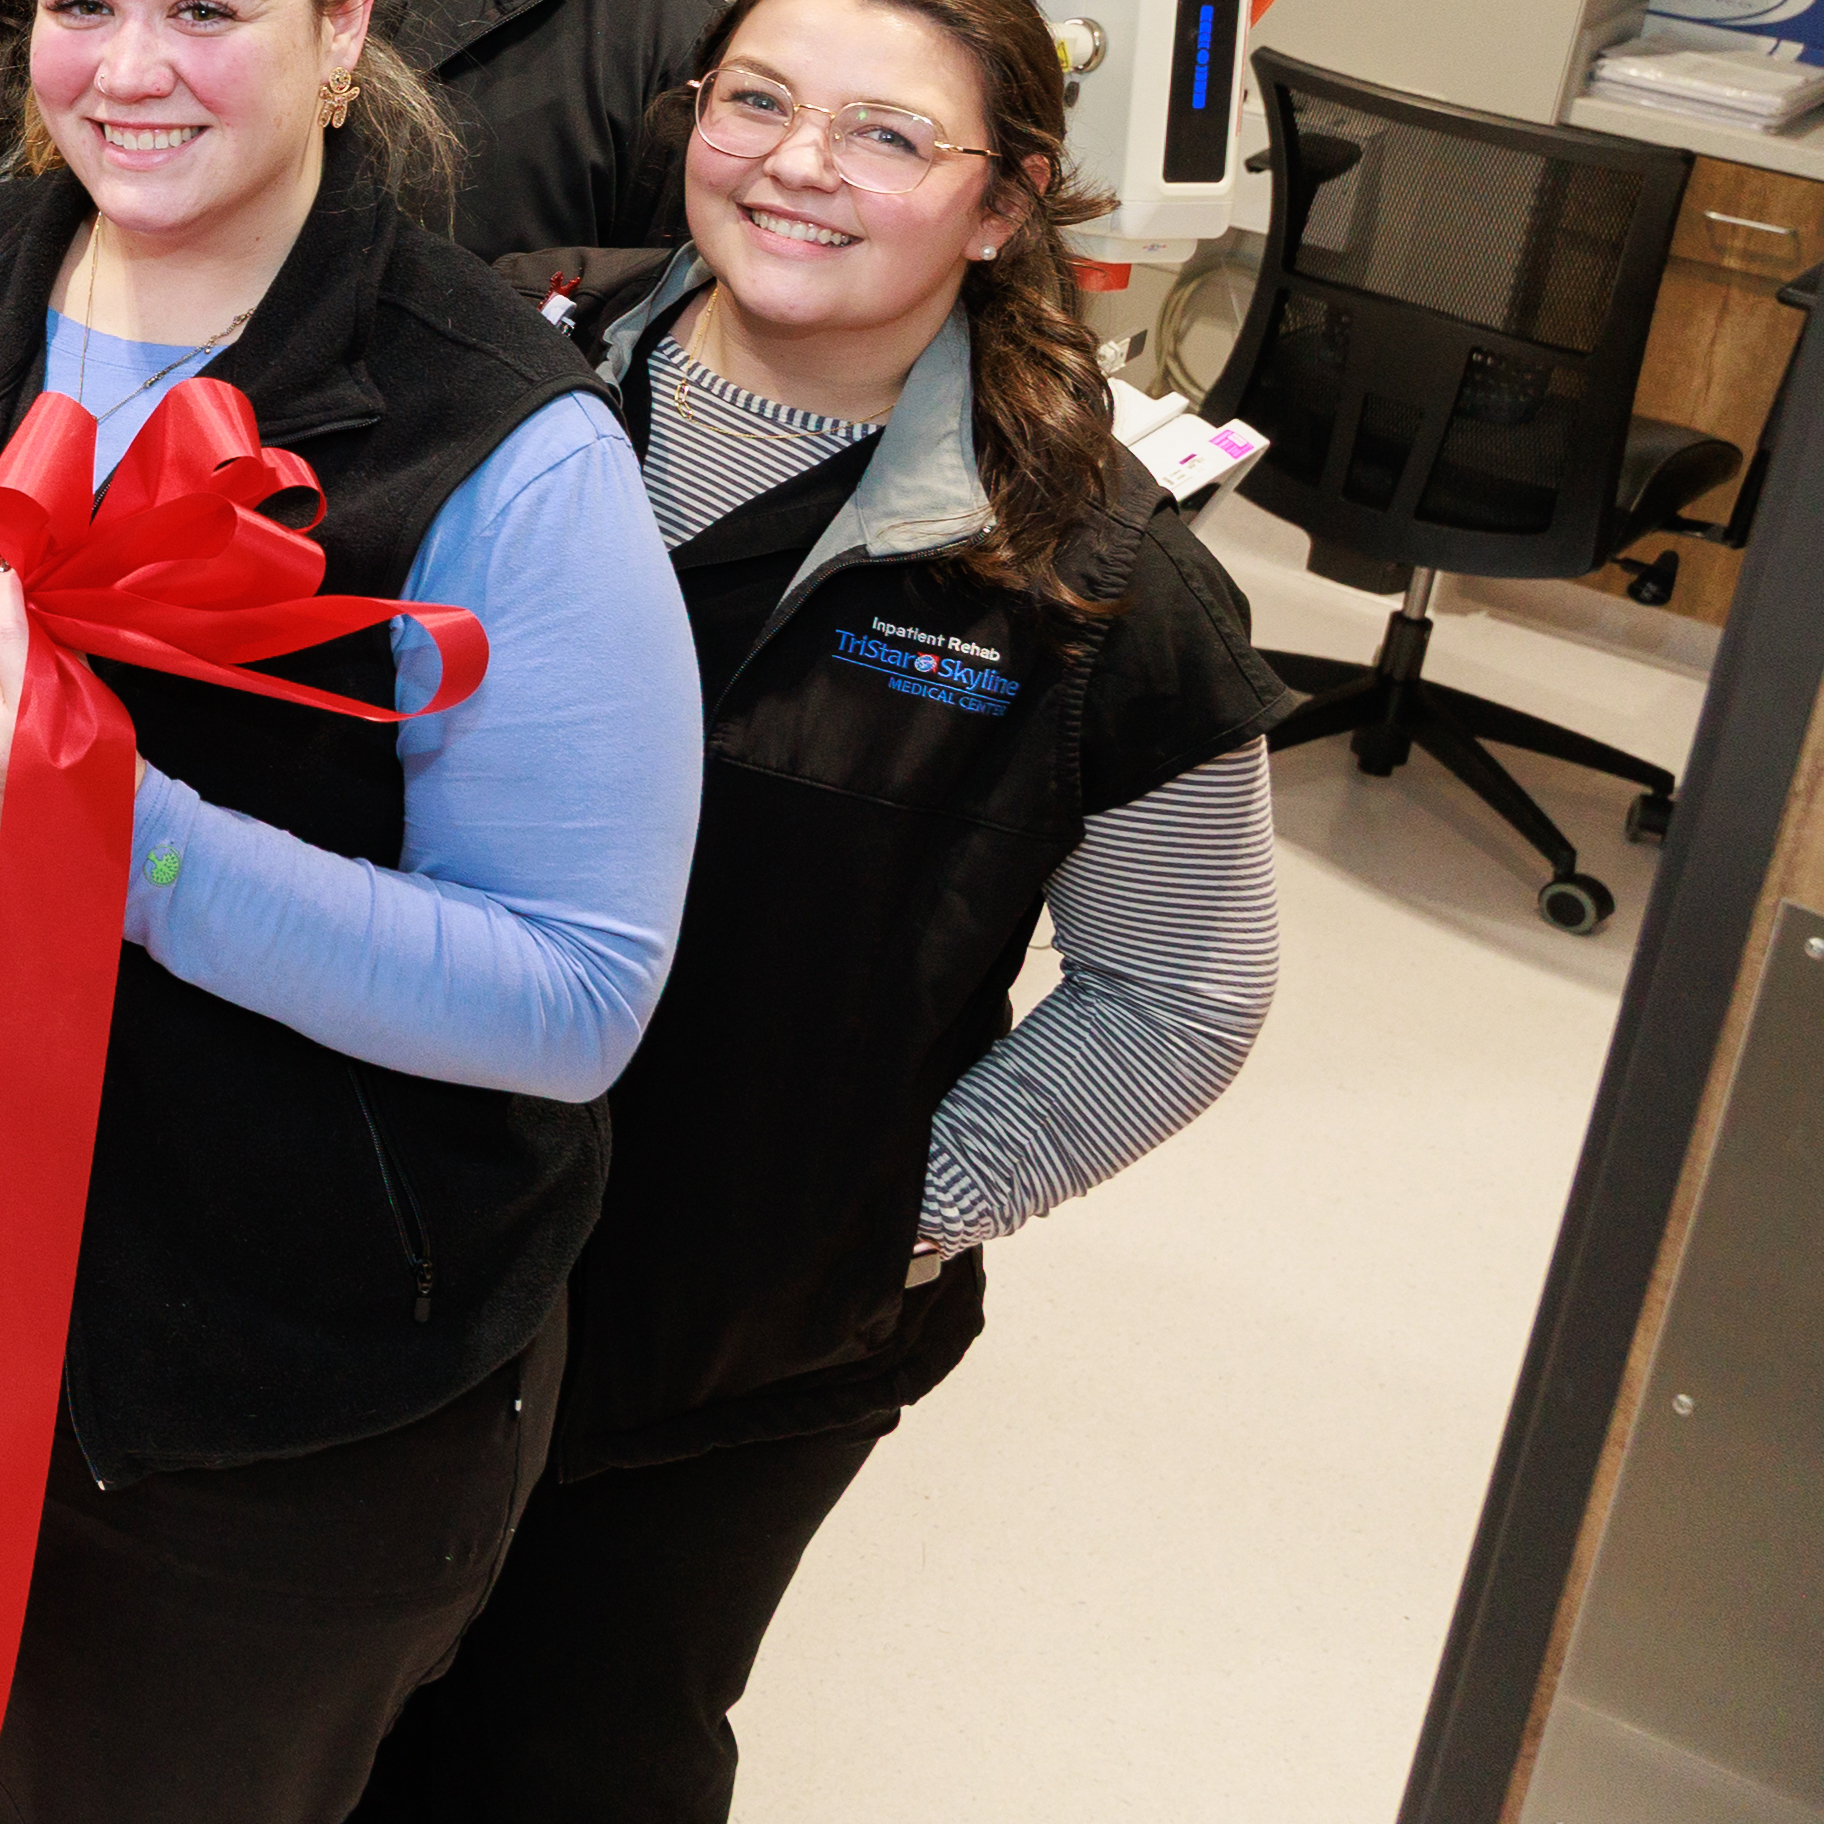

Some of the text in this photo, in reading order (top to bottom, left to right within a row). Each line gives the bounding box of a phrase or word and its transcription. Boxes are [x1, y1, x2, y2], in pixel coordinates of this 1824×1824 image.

[871, 616, 1001, 662] Inpatient Rehab
[835, 629, 1020, 696] TriStar Skyline
[888, 676, 956, 705] MEDICAL
